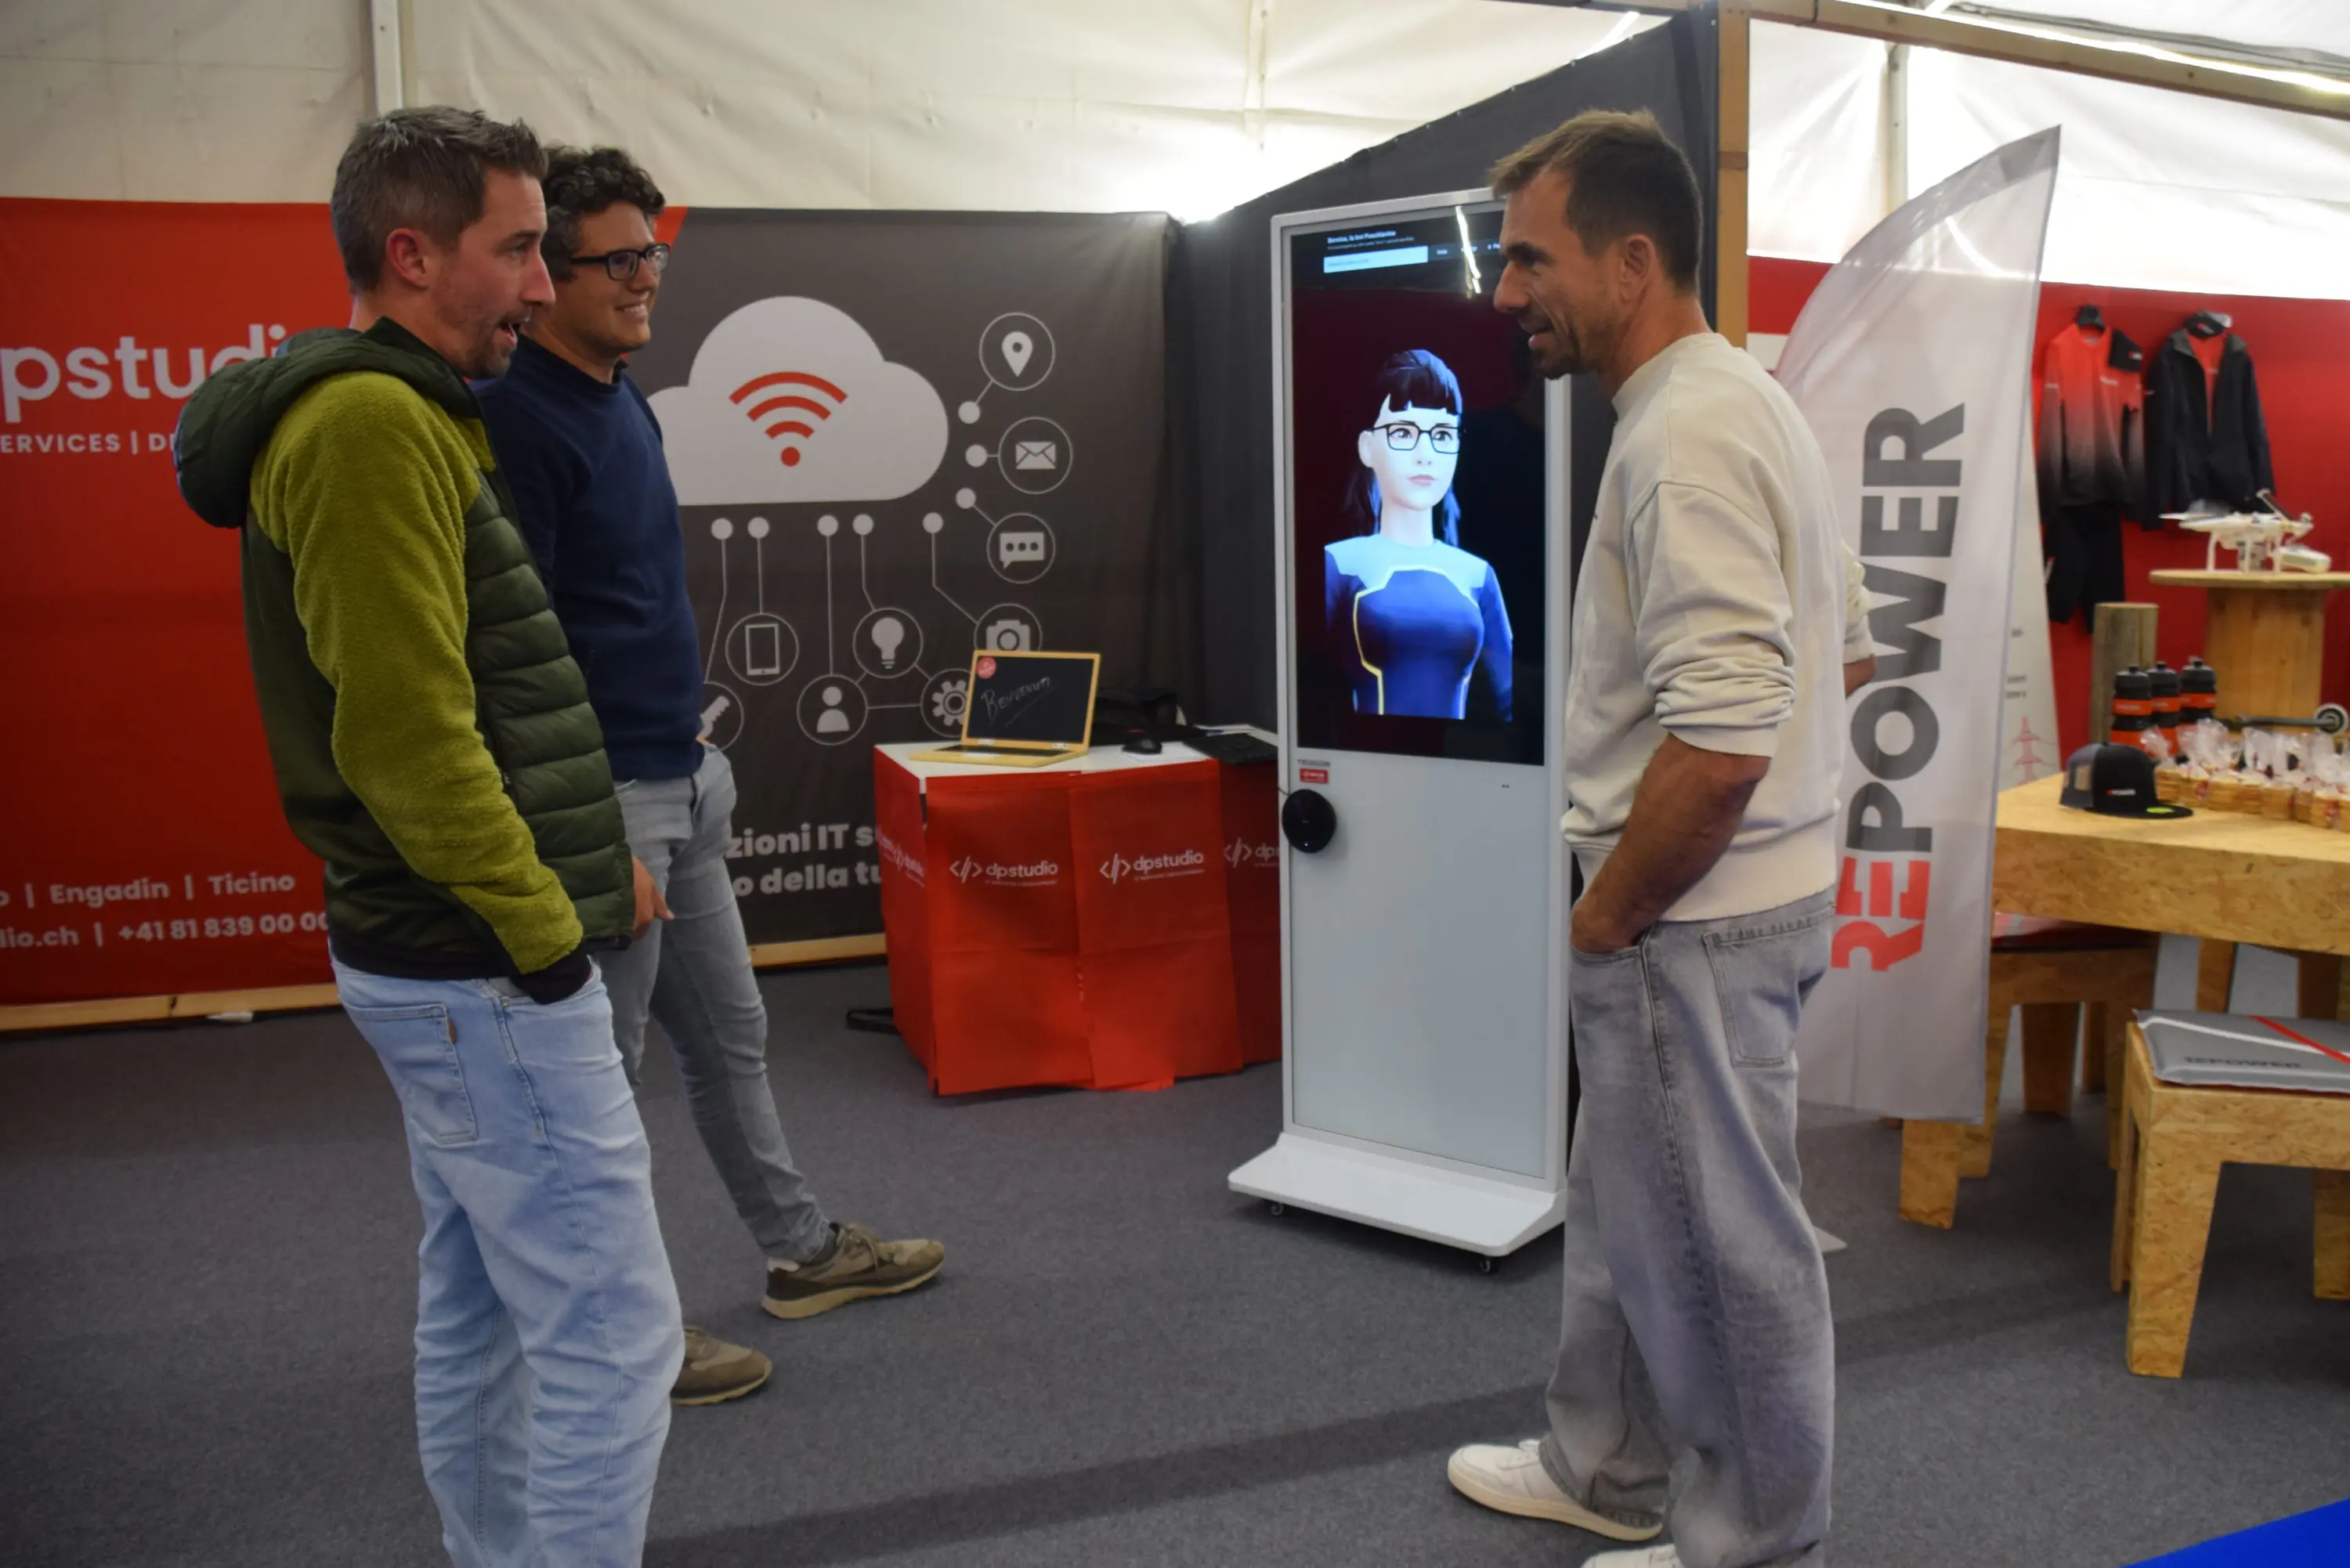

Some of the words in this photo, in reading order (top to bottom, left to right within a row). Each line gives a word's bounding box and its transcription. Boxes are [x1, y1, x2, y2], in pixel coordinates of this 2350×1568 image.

[0, 432, 121, 453] ERVICES
[1831, 403, 1965, 972] REPOWER
[816, 823, 850, 851] IT
[985, 859, 1058, 880] dpstudio
[1133, 848, 1205, 875] dpstudio
[49, 877, 170, 909] Engadin
[208, 871, 296, 895] Ticino
[759, 864, 848, 895] della
[118, 920, 164, 942] +41
[170, 919, 198, 940] 81
[204, 916, 255, 938] 839
[259, 913, 294, 934] 00
